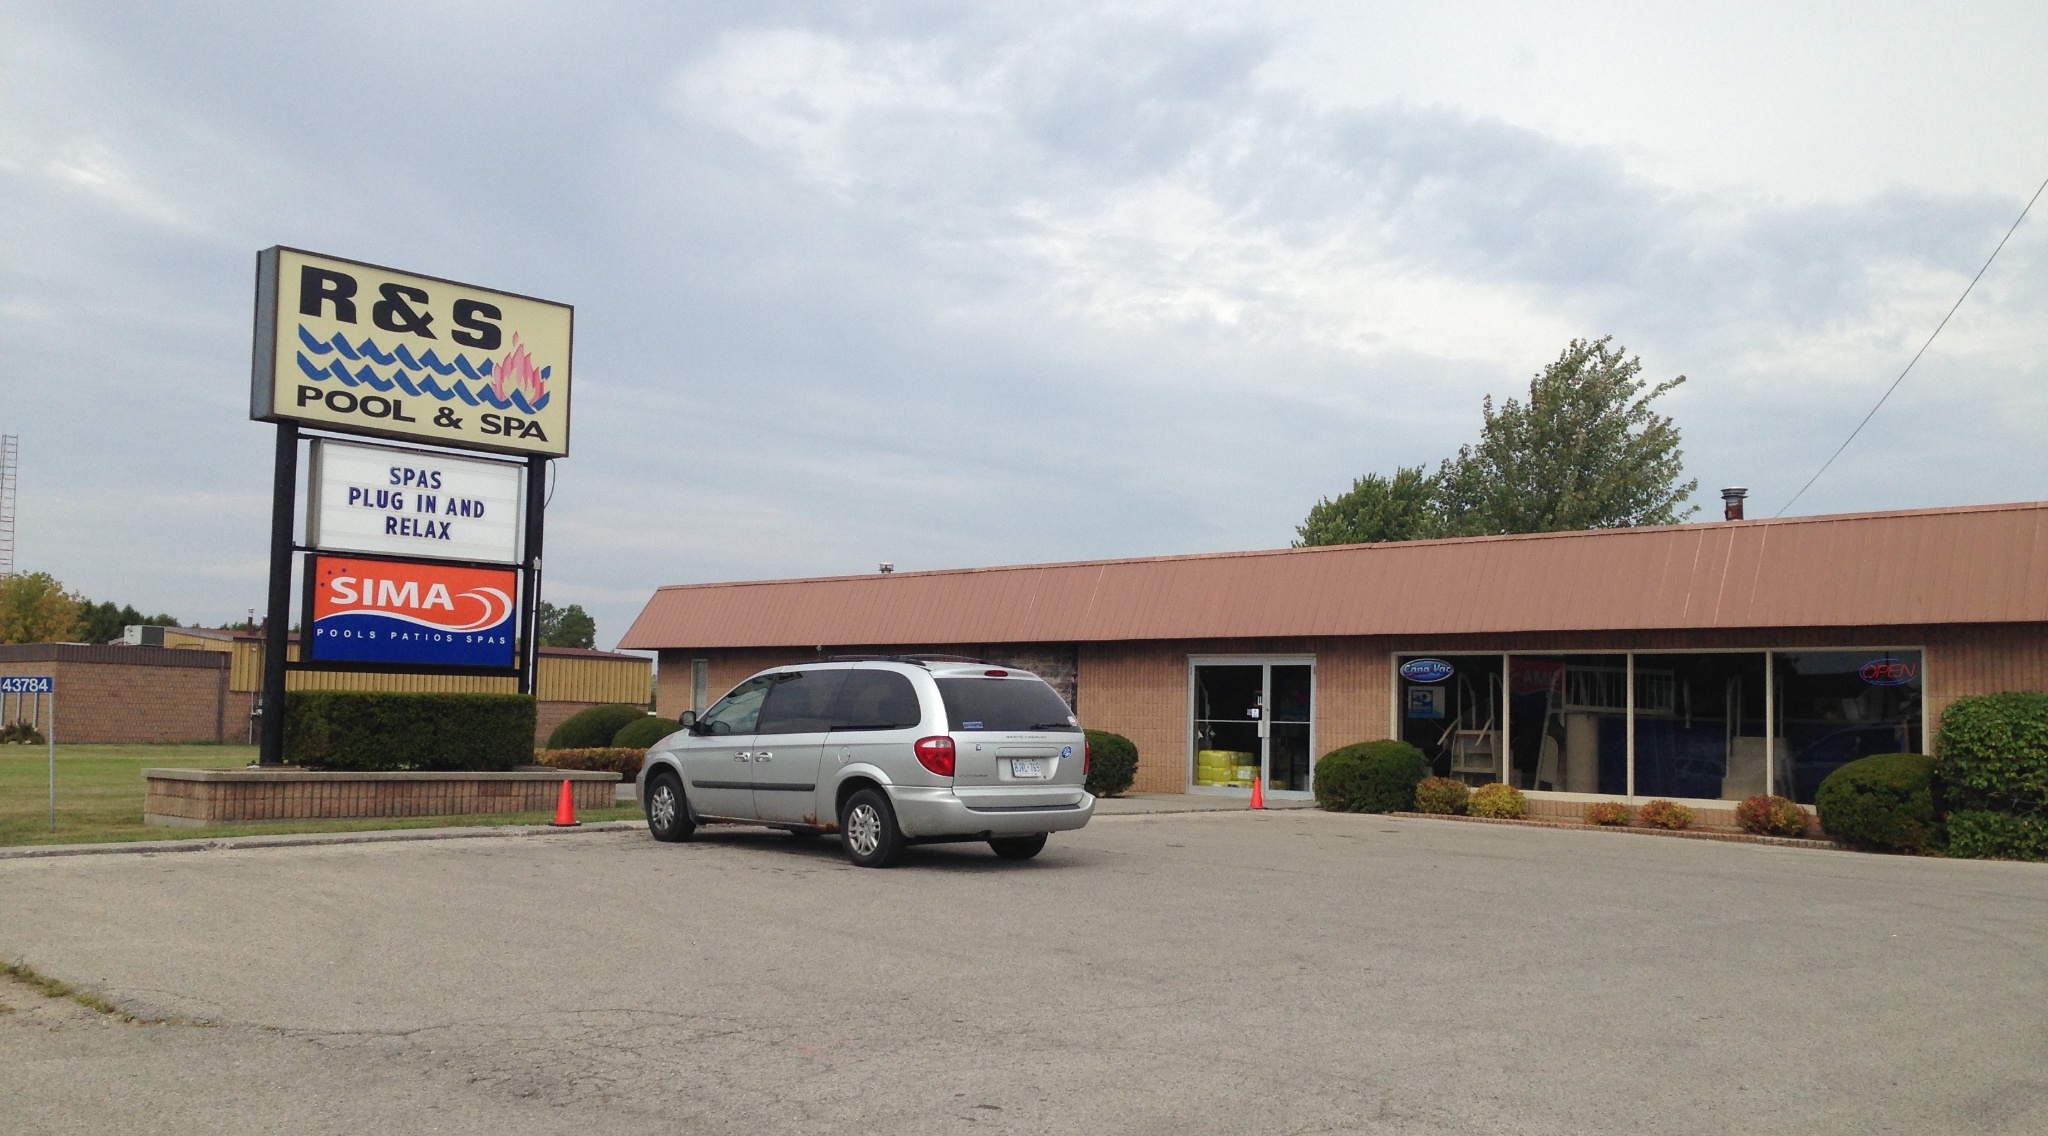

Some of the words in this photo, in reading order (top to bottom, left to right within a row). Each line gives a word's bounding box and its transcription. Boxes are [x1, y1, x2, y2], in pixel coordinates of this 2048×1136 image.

[297, 385, 416, 423] POOL
[433, 407, 463, 430] &
[480, 413, 549, 443] SPA
[389, 467, 442, 489] SPAS
[349, 486, 403, 511] PLUG
[417, 494, 437, 514] IN
[446, 498, 485, 518] AND
[385, 516, 451, 540] RELAX
[330, 576, 454, 611] SIMA
[316, 628, 376, 639] POOLS
[390, 631, 453, 642] PATIOS
[466, 634, 506, 645] SPAS
[1404, 664, 1430, 674] Cana
[1433, 664, 1451, 673] Vac
[1863, 663, 1917, 678] OPEN
[2, 678, 48, 692] 43784
